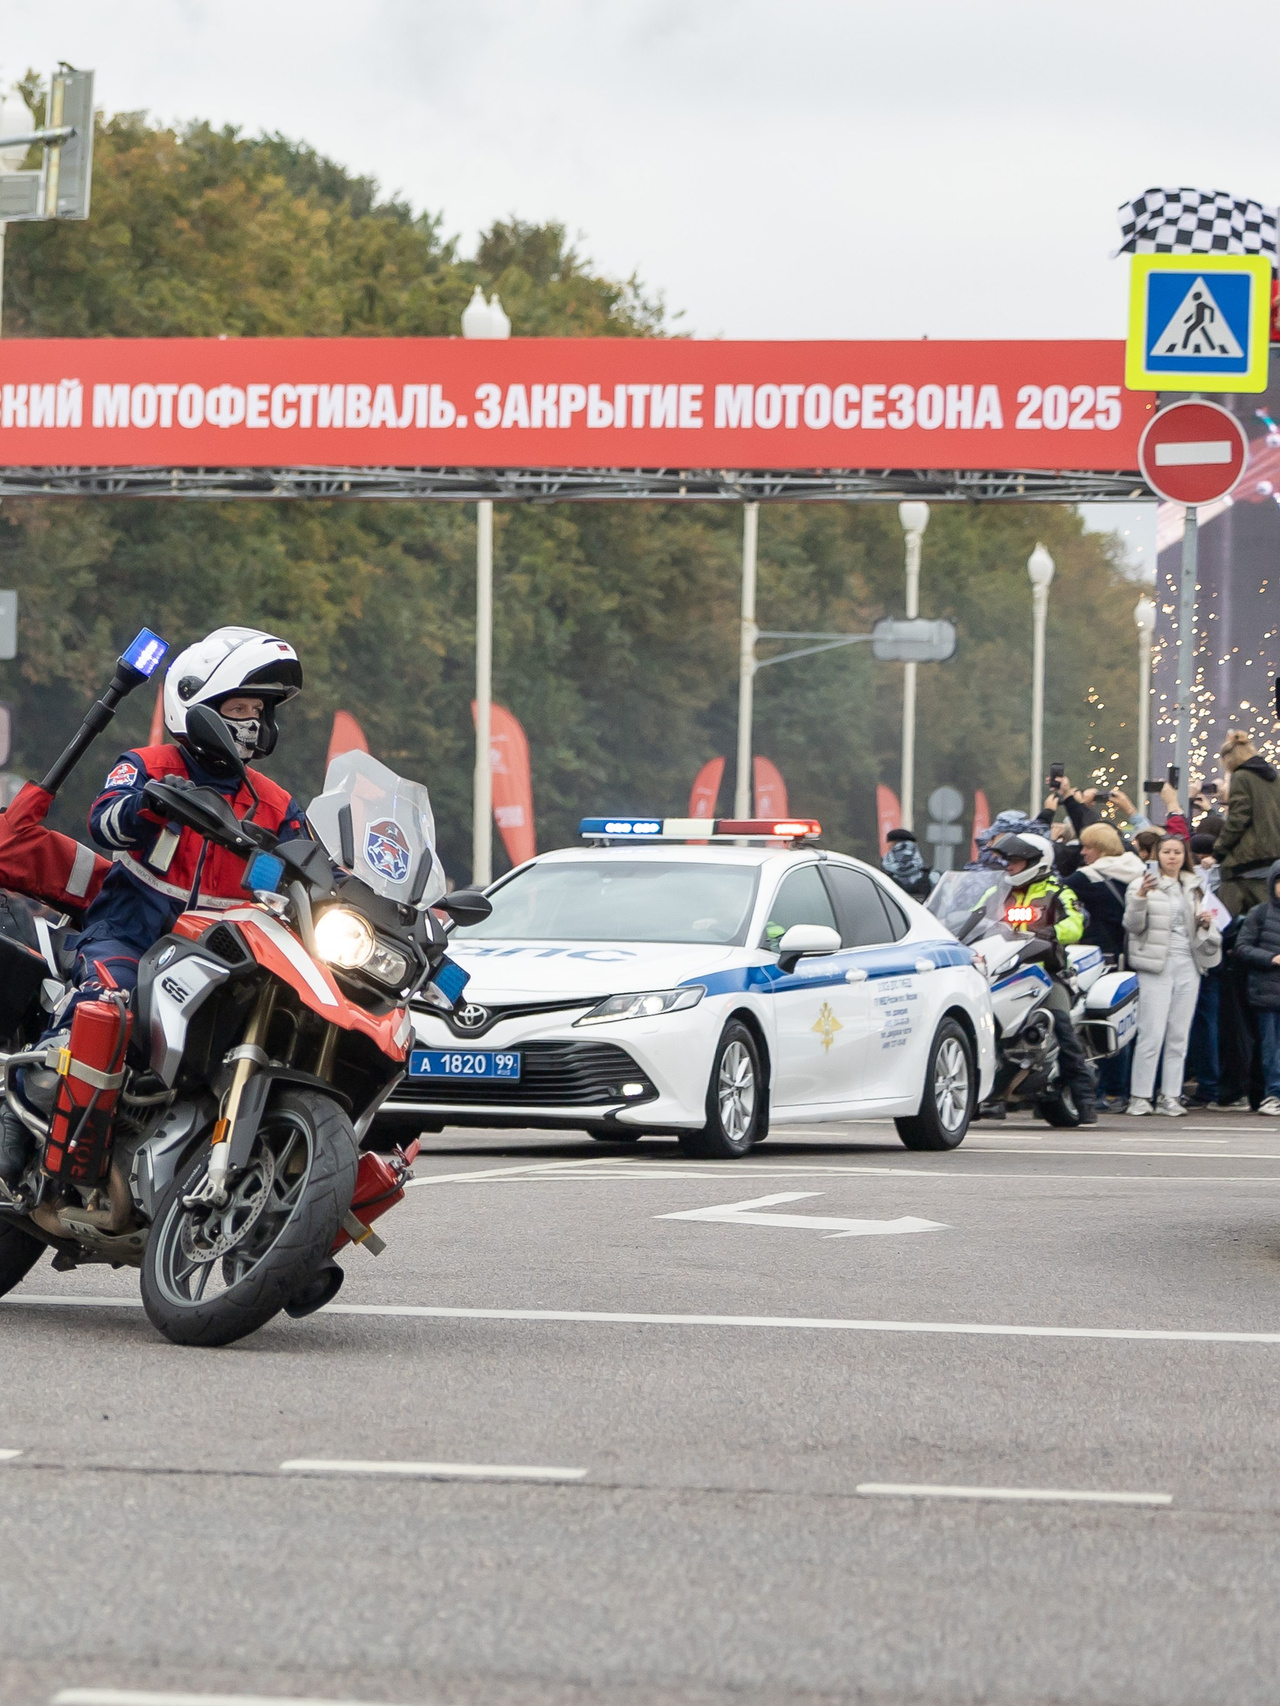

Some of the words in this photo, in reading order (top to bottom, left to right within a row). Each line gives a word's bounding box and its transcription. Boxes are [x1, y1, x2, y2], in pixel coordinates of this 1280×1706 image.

[91, 383, 468, 430] МОТОФЕСТИВАЛЬ.
[474, 383, 703, 430] ЗАКРЫТИЕ
[714, 384, 1003, 430] МОТОСЕЗОНА
[1016, 384, 1122, 431] 2025
[161, 975, 190, 1004] GS
[440, 1054, 487, 1074] 1820
[495, 1054, 514, 1070] 99
[181, 1163, 202, 1191] brembo
